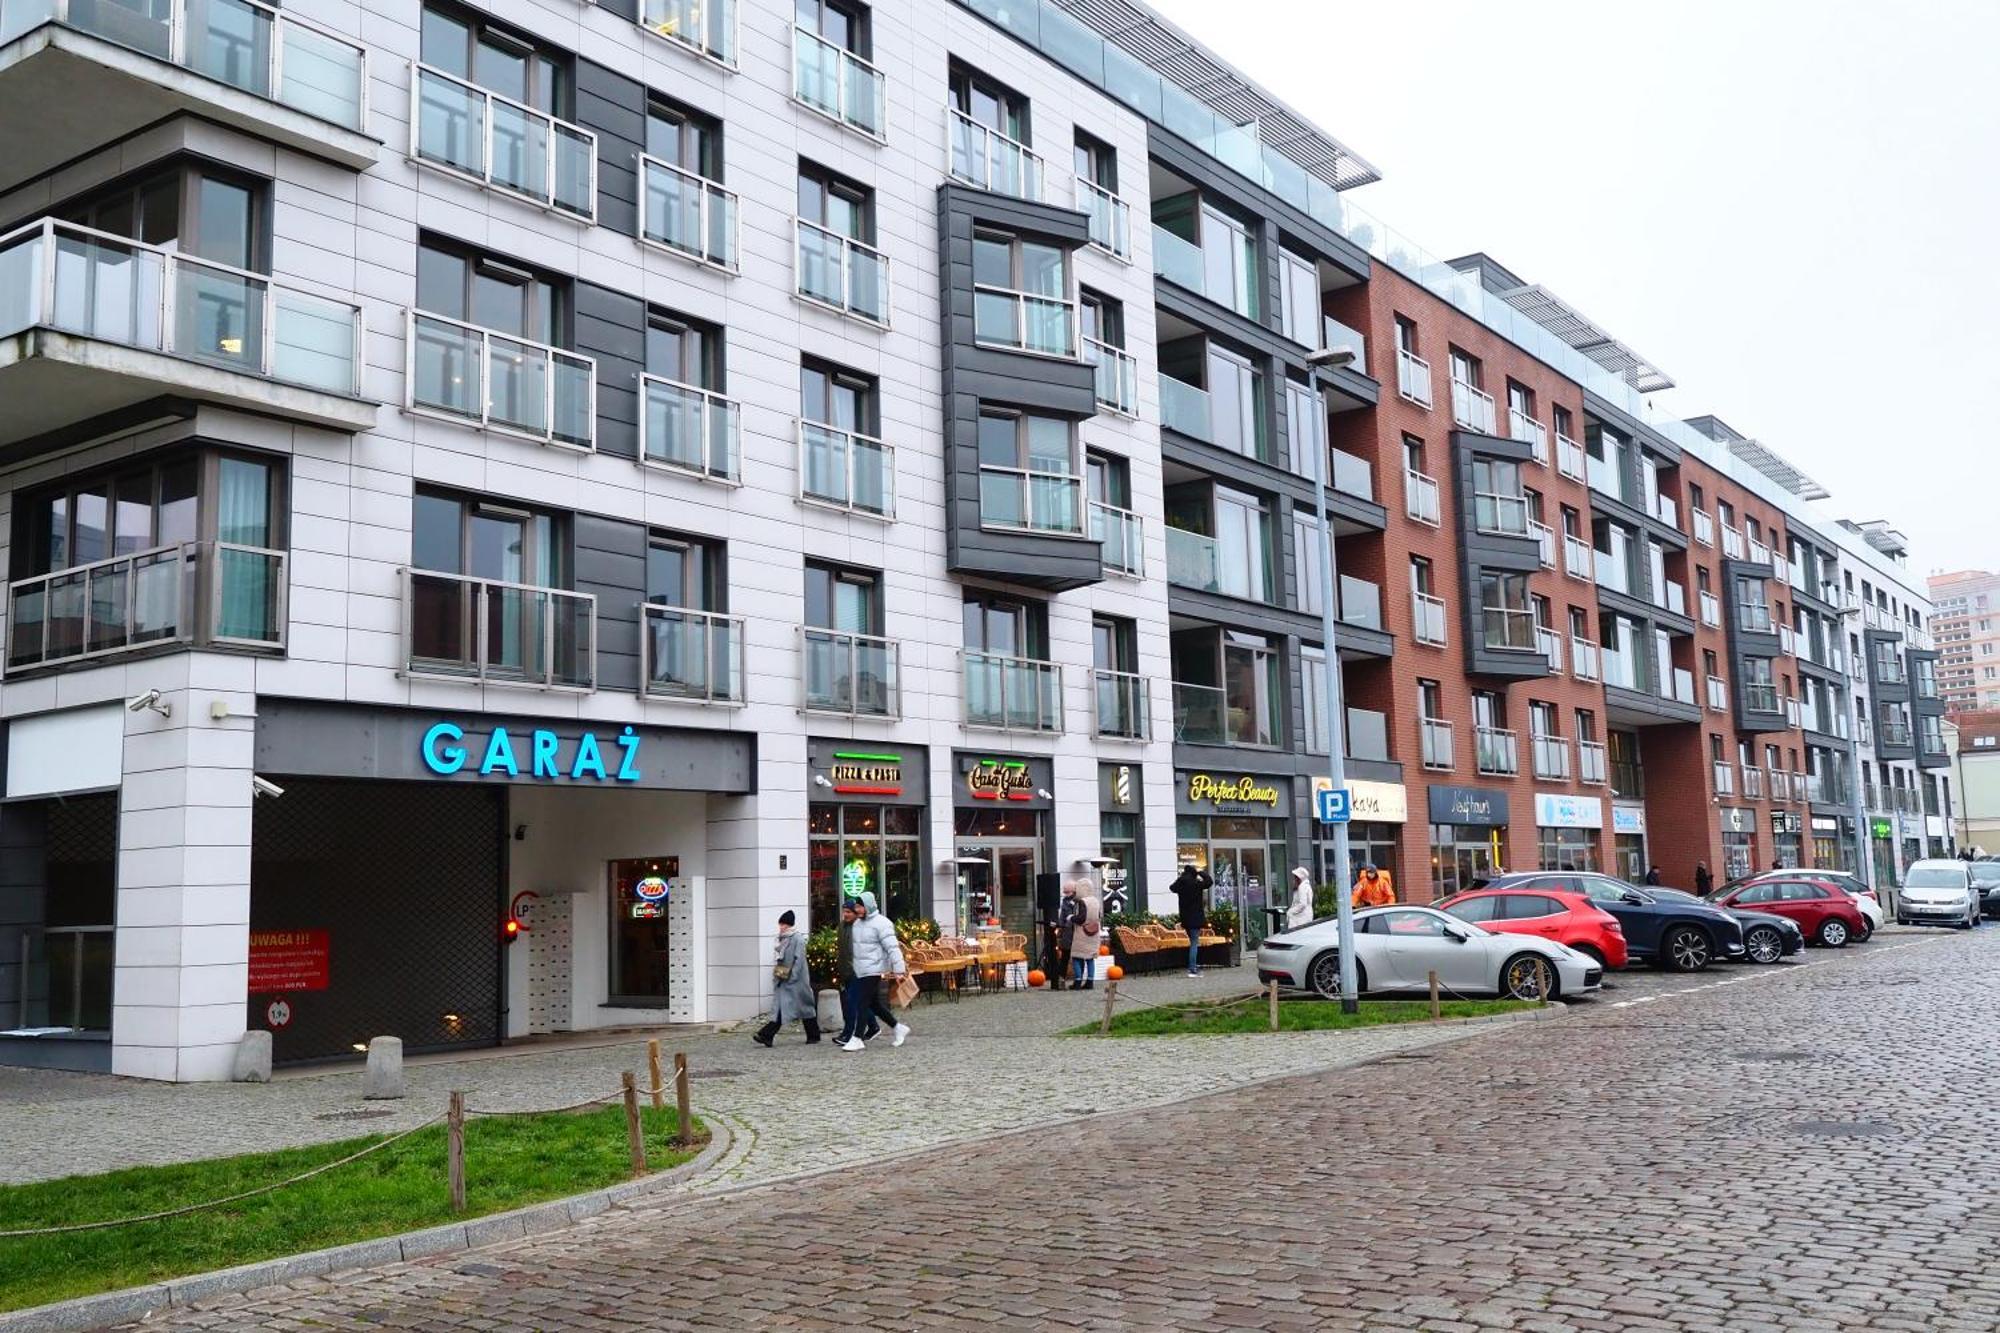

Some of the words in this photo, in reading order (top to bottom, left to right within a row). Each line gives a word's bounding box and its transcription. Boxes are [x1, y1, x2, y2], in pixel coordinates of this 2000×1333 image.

[422, 723, 641, 781] GARAŻ
[835, 766, 862, 780] PIZZA
[865, 769, 872, 781] &
[874, 768, 901, 782] PASTA
[972, 766, 1000, 789] Casa
[1001, 767, 1033, 799] Gusto
[1191, 774, 1238, 805] Perfect
[1239, 776, 1279, 808] Beauty
[1350, 784, 1380, 813] kaya
[1326, 793, 1344, 819] P
[640, 884, 664, 895] PIZZA
[516, 904, 531, 918] LP
[250, 933, 293, 947] UWAGA
[296, 932, 310, 945] !!!
